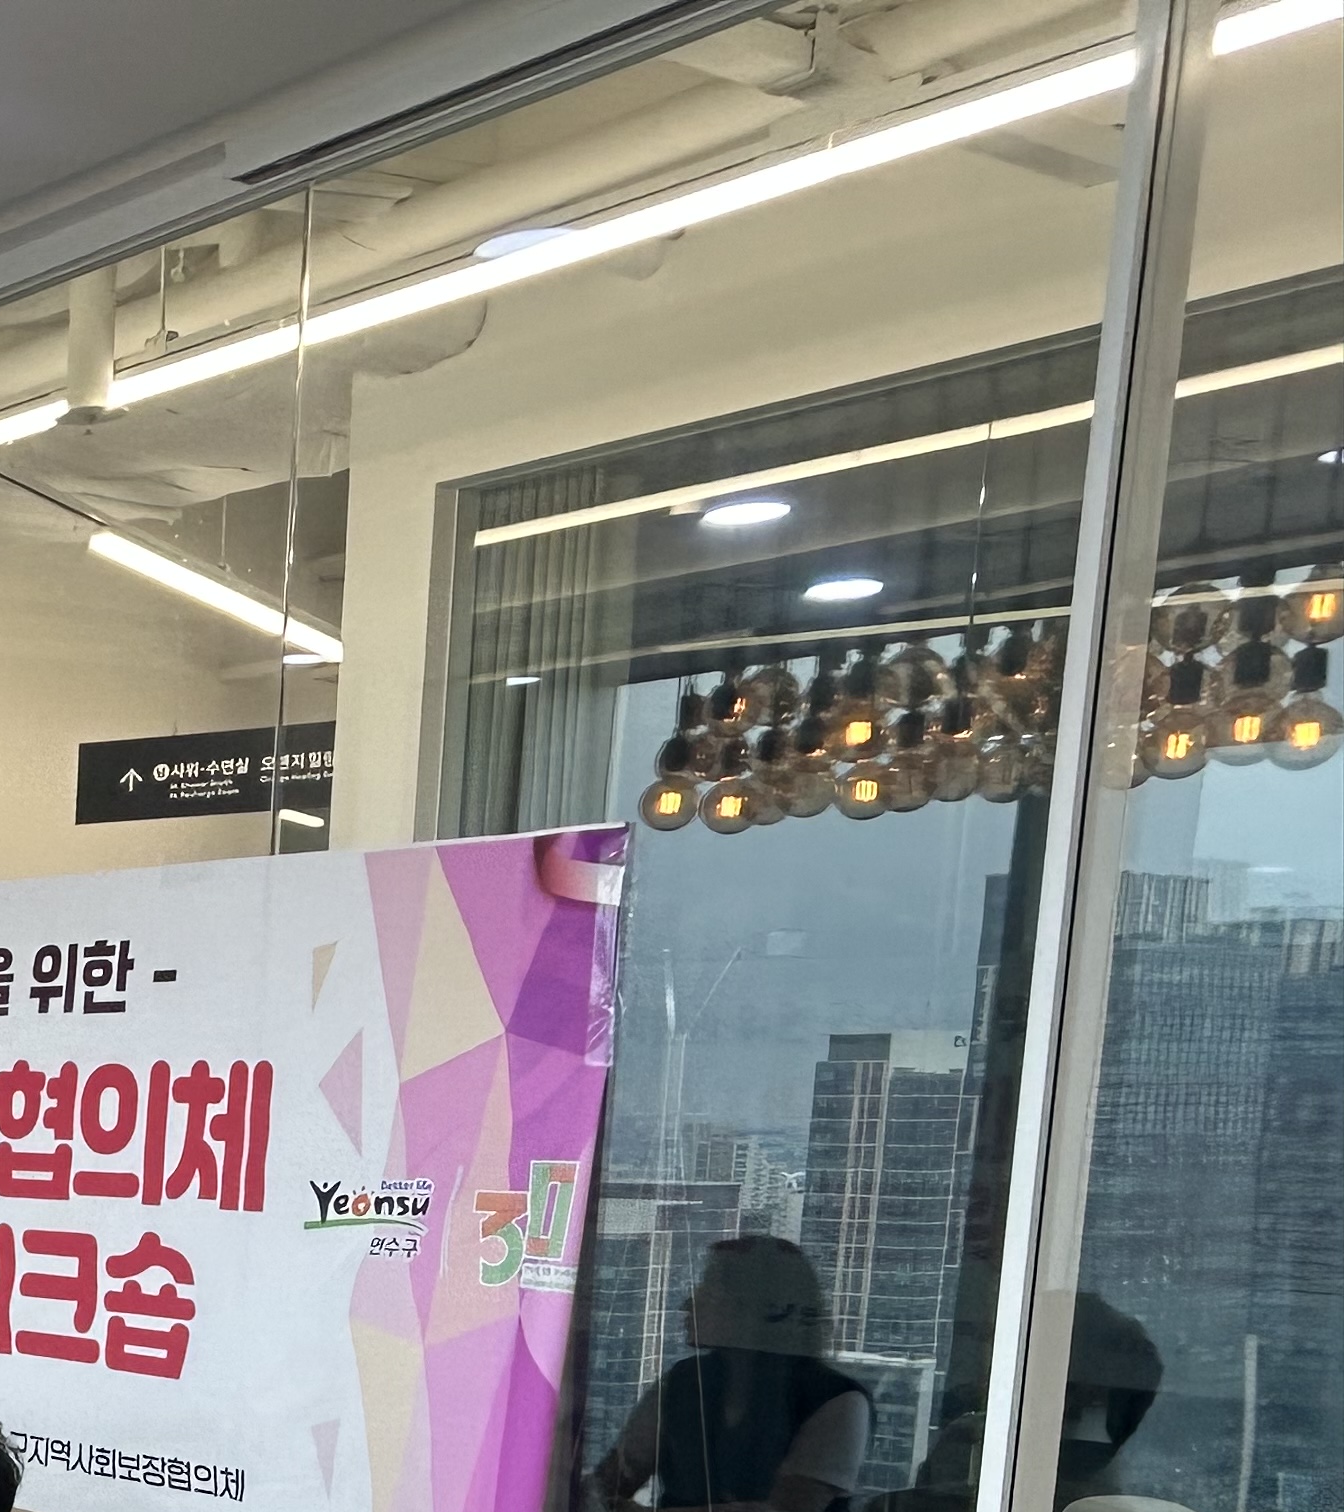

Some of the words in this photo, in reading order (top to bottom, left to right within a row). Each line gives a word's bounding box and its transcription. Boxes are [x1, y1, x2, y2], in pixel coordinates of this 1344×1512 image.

[29, 939, 134, 1014] 위한
[310, 1180, 431, 1224] Yeonsu
[370, 1236, 420, 1258] 연수구
